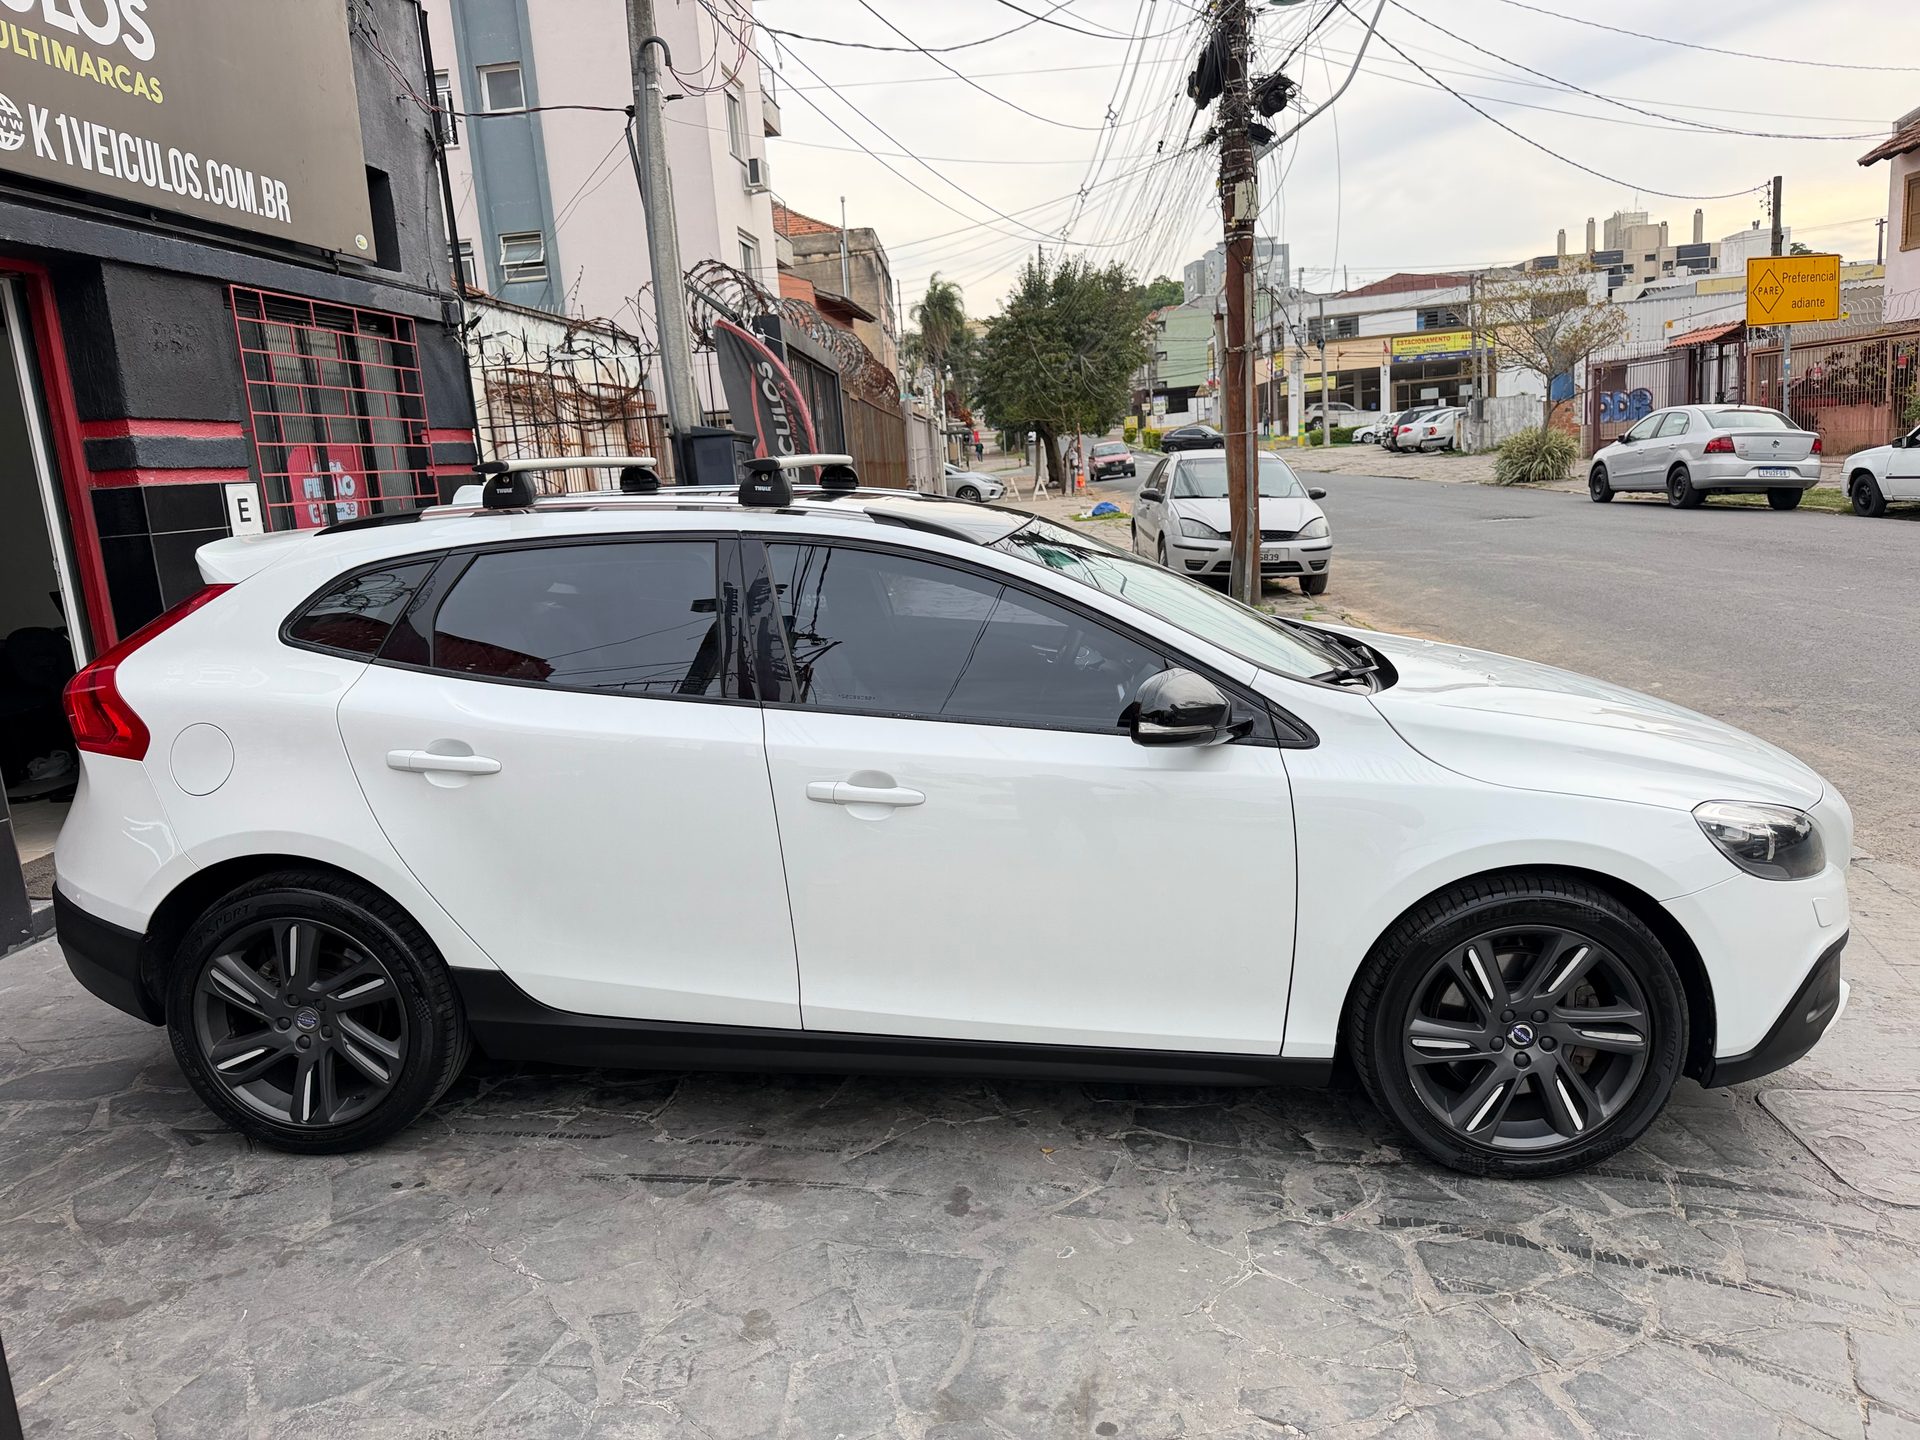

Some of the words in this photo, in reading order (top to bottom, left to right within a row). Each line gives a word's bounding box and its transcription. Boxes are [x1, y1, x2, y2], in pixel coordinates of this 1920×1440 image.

[1782, 270, 1836, 283] Preferencial
[1758, 286, 1779, 295] PARE
[1791, 296, 1825, 309] adiante
[1396, 335, 1451, 346] ESTACIONAMENTO
[237, 497, 251, 522] E
